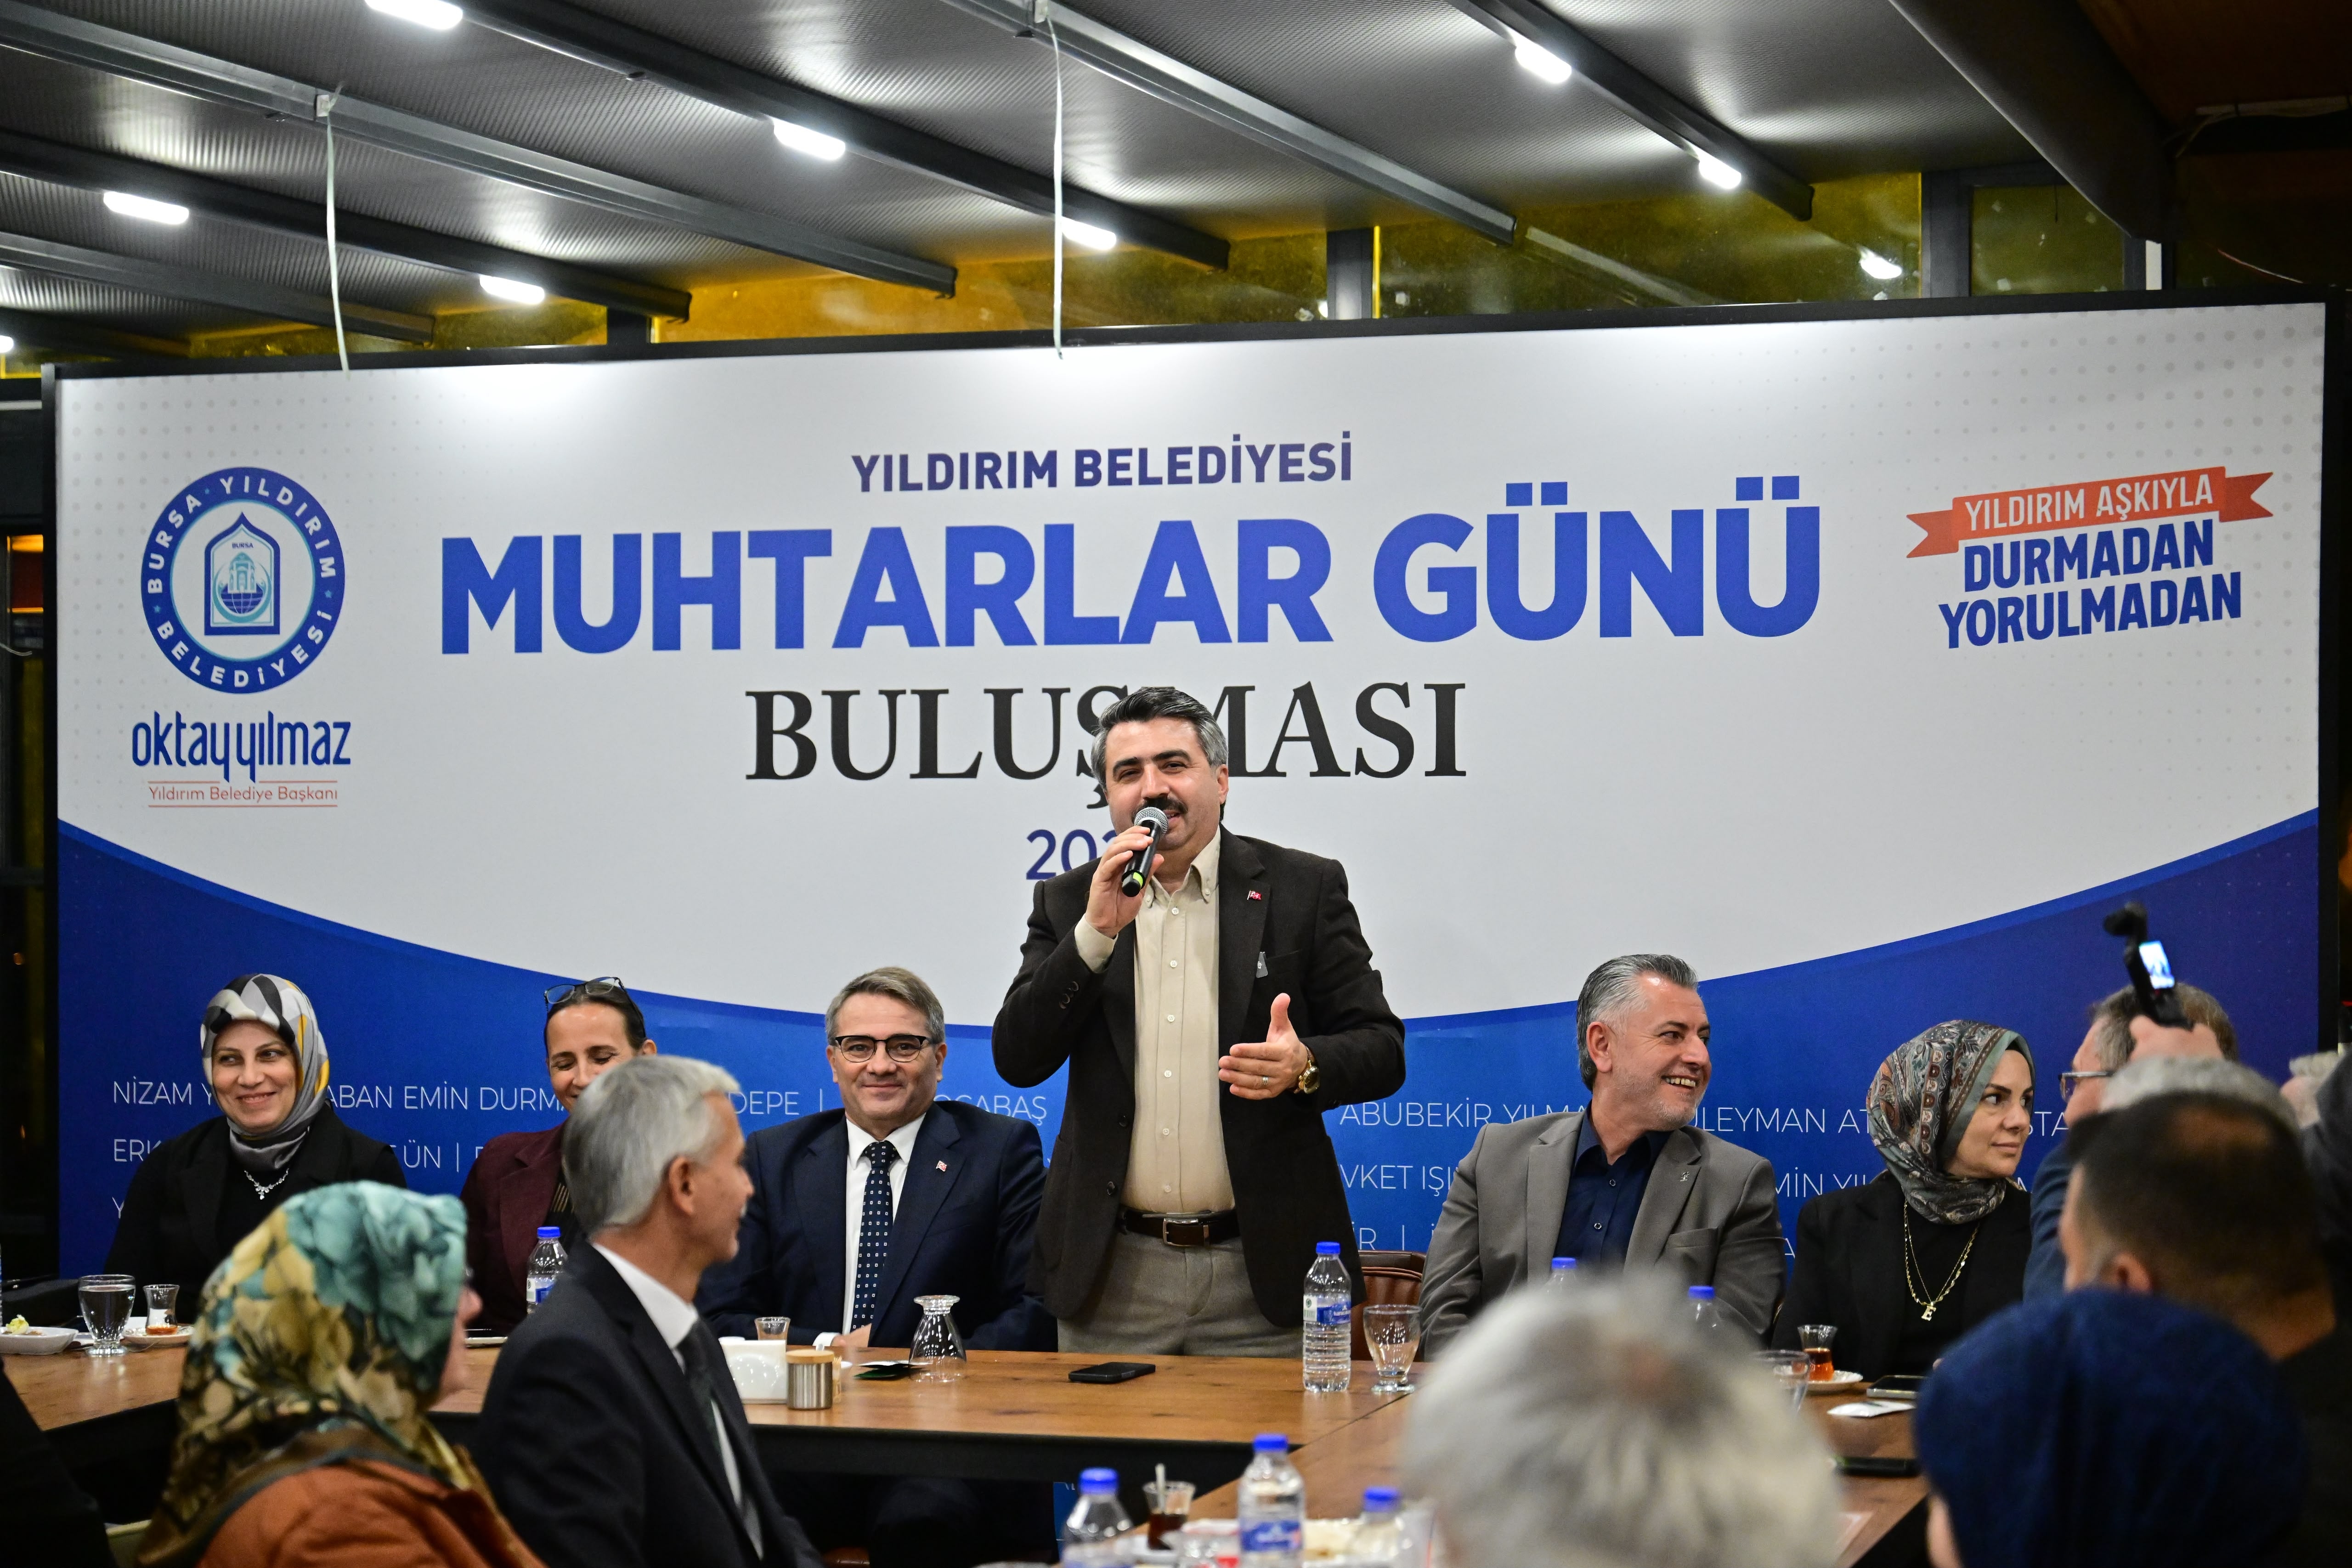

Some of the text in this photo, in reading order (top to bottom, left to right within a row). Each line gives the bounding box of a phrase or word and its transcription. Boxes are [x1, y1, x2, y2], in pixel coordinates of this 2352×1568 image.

[851, 431, 1351, 492] YILDIRIM BELEDİYESİ
[1965, 474, 2213, 530] YILDIRIM AŞKIYLA
[147, 476, 336, 688] BURSA YILDIRIM BELEDİYESİ
[442, 475, 1820, 654] MUHTARLAR GÜNÜ
[1964, 519, 2213, 592] DURMADAN
[1939, 571, 2241, 649] YORULMADAN
[149, 786, 337, 803] Yıldırım Belediye Başkanı
[1026, 829, 1117, 880] 20
[114, 1076, 192, 1105] NİZAM
[404, 1081, 468, 1110] EMİN
[1340, 1097, 1492, 1127] ABUBEKİR
